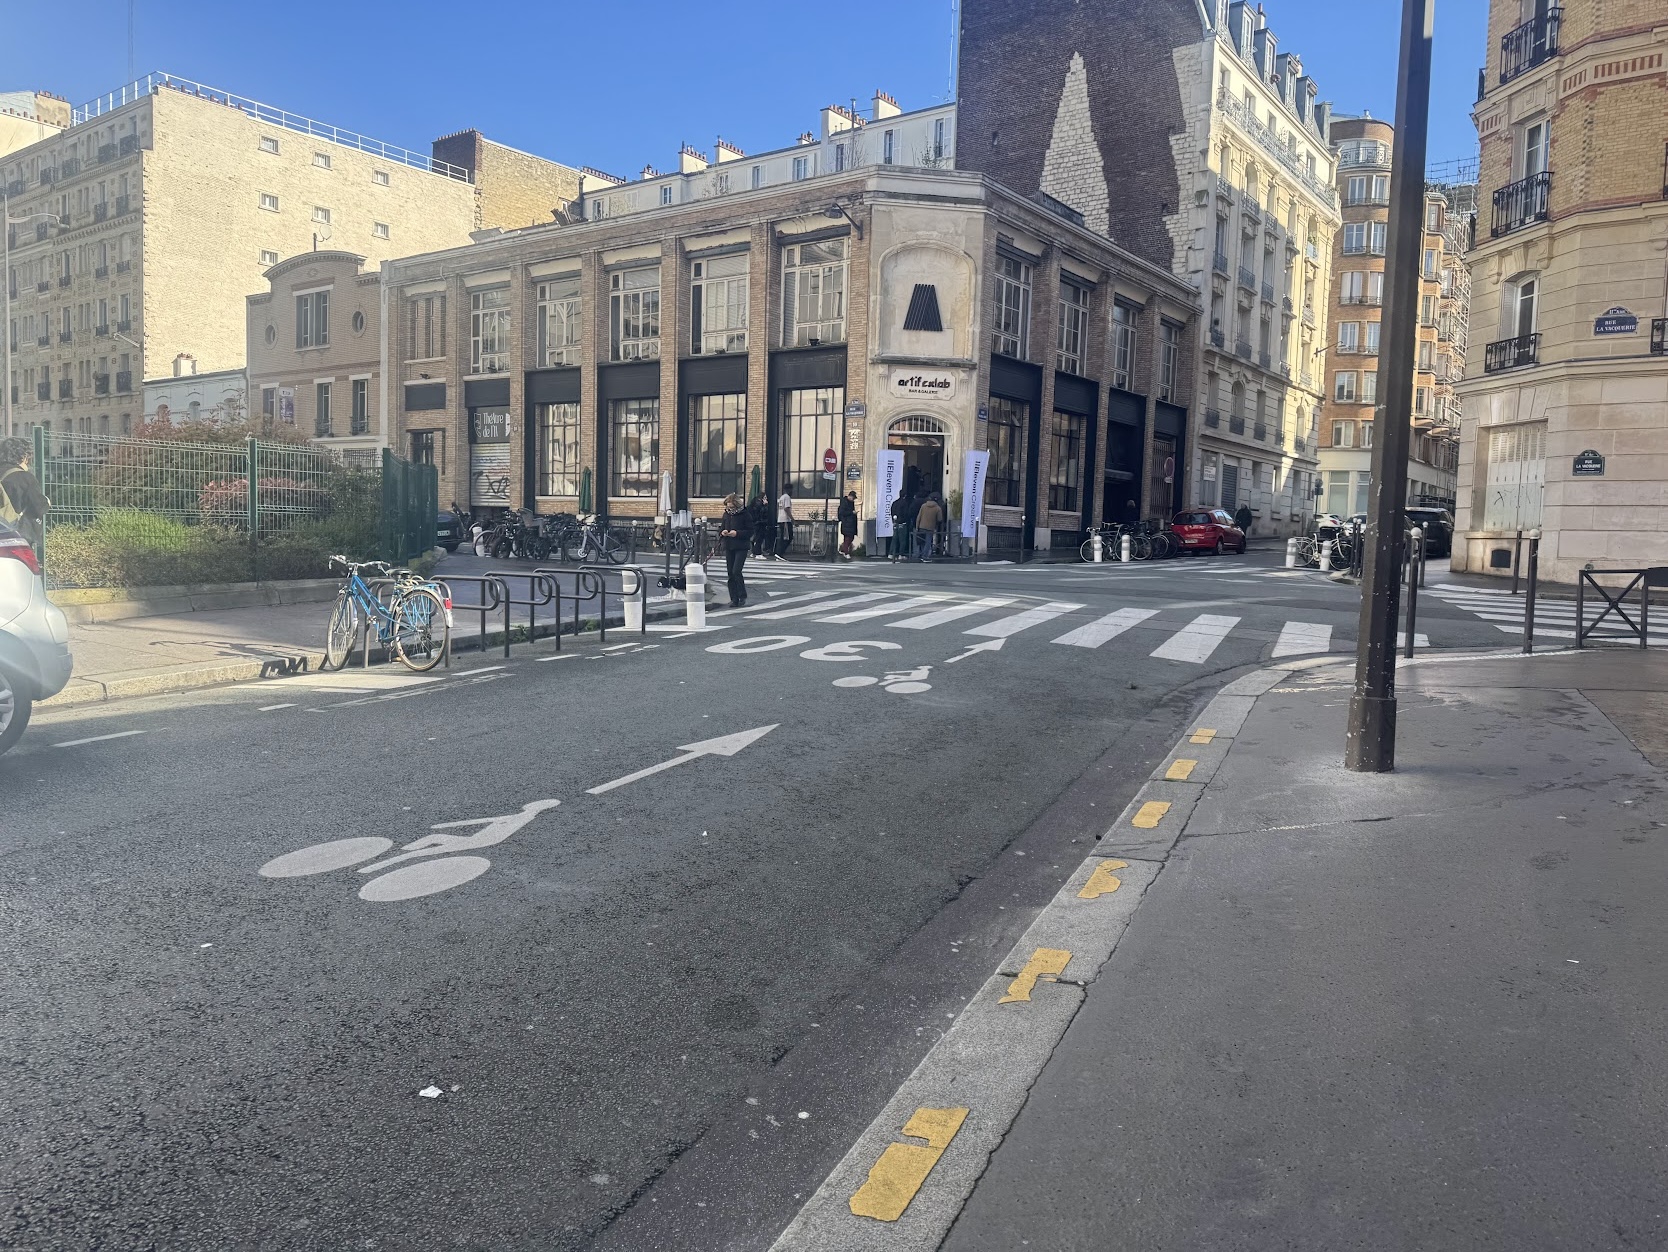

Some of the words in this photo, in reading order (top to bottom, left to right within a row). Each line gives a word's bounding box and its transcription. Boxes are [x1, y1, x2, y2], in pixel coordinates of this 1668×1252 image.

[884, 493, 894, 529] Creative
[970, 494, 978, 529] Creative
[704, 634, 903, 662] 30
